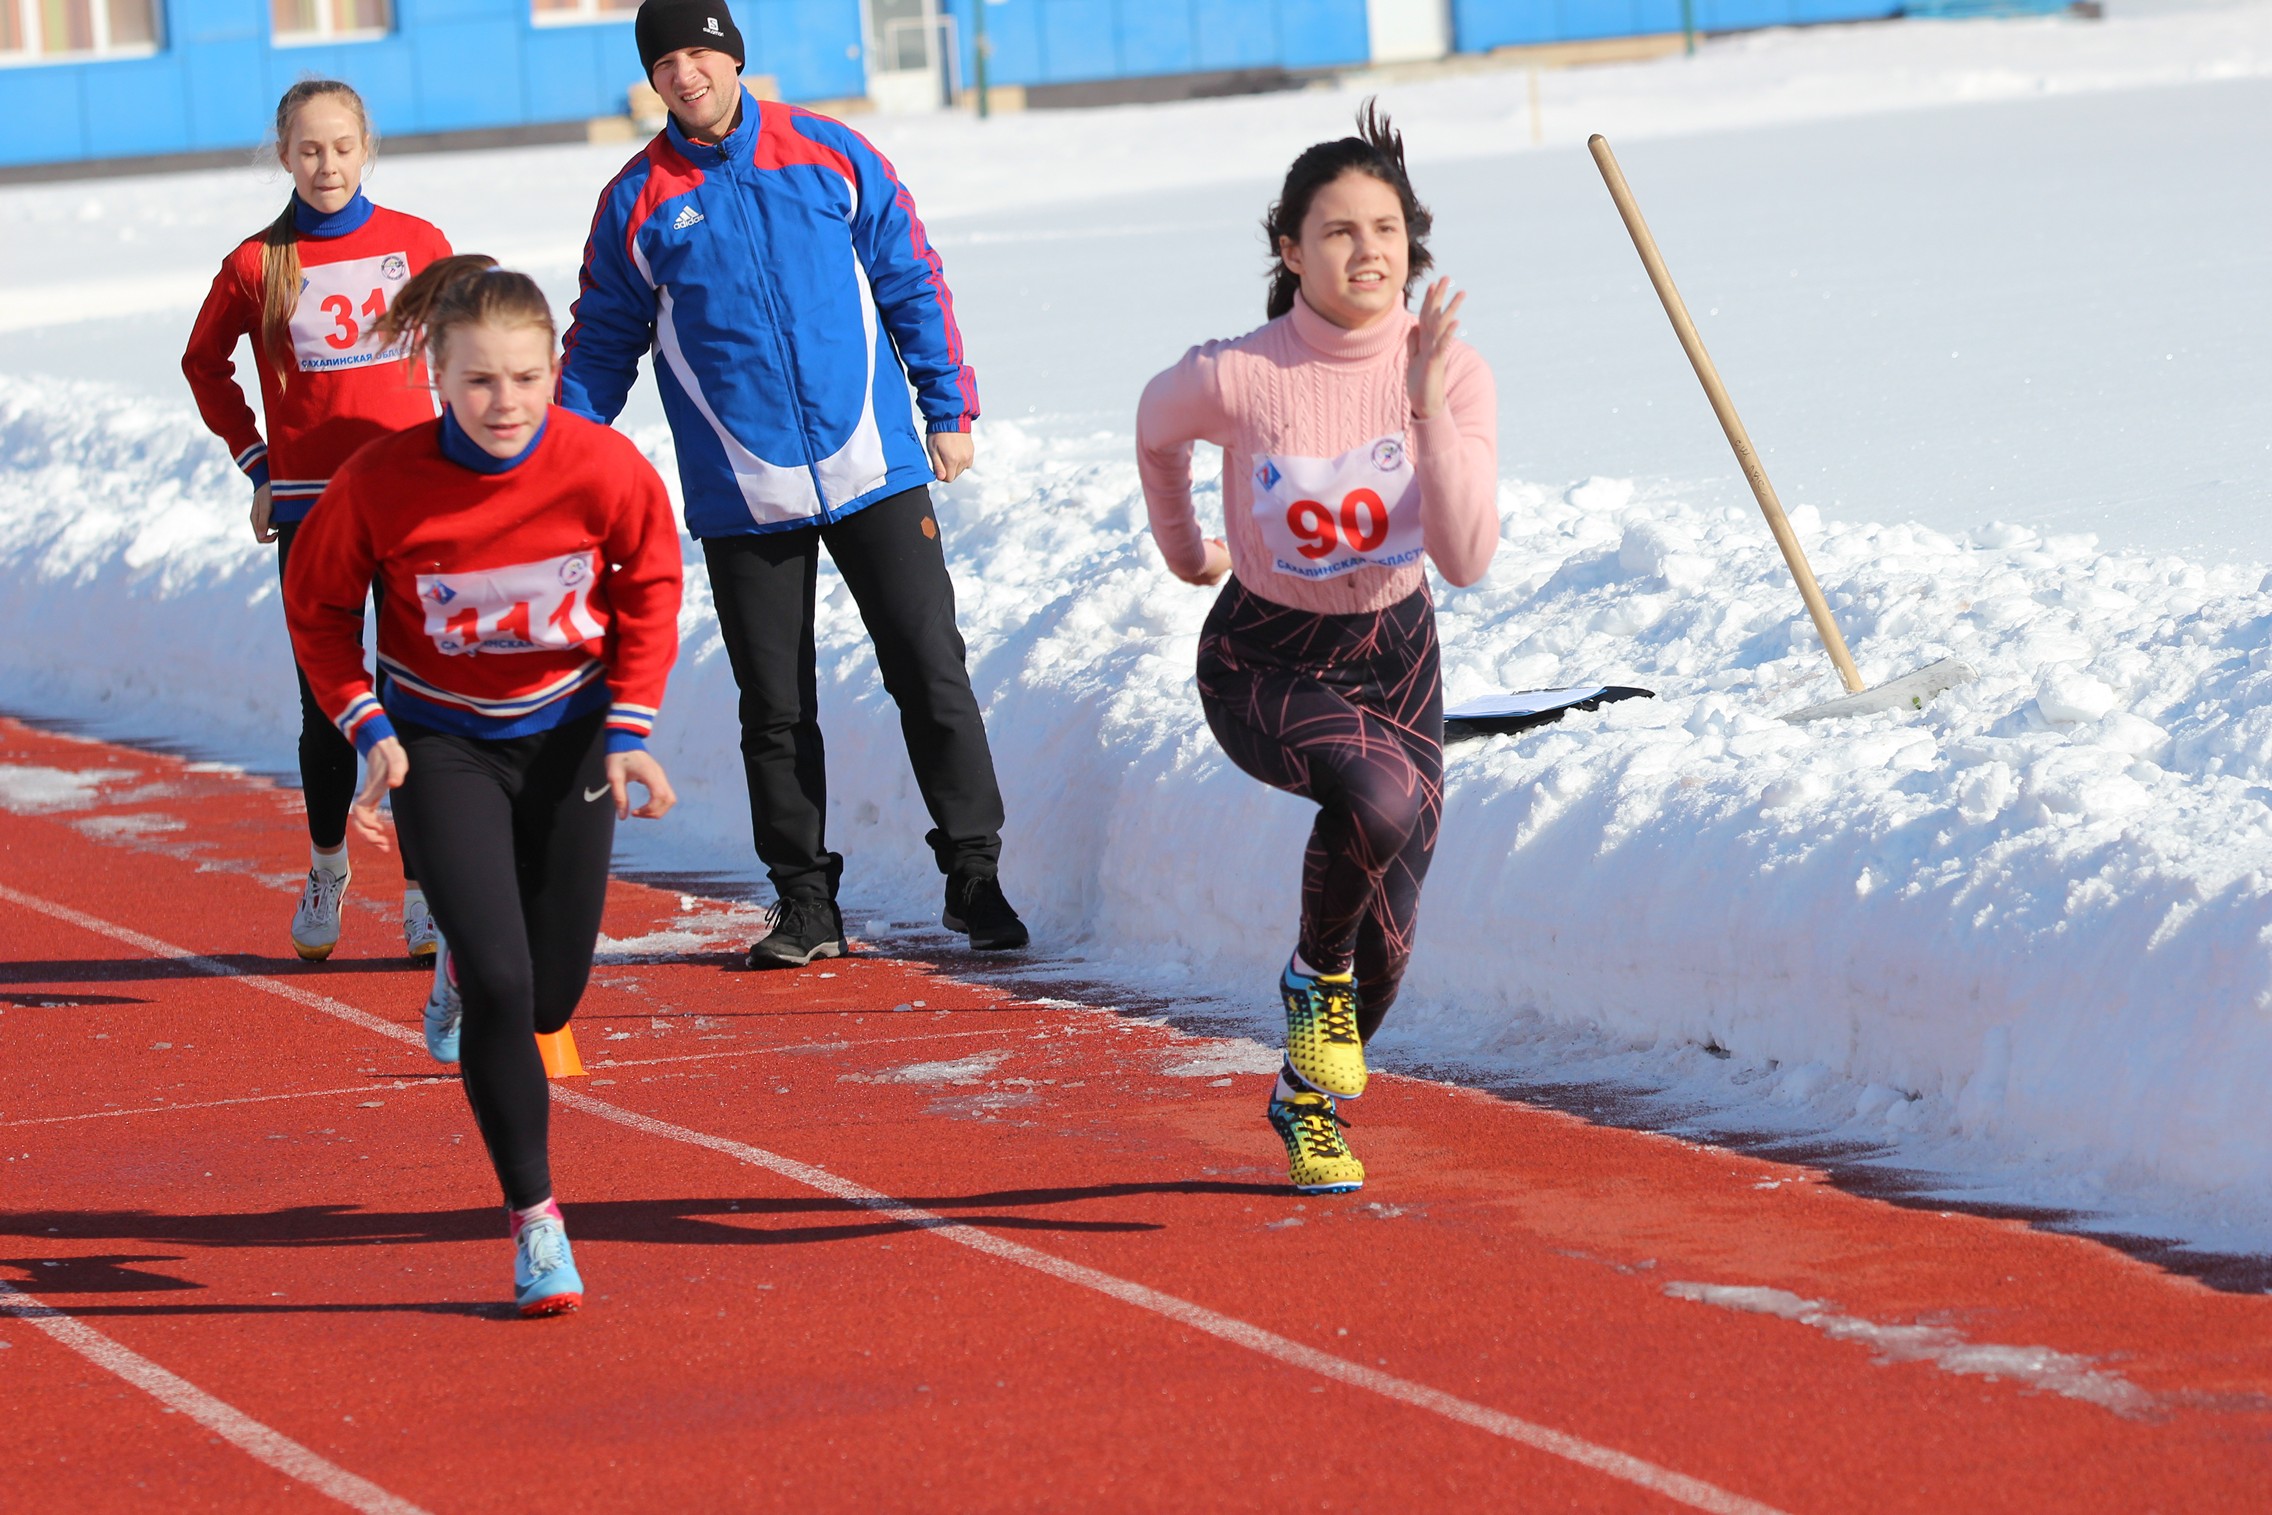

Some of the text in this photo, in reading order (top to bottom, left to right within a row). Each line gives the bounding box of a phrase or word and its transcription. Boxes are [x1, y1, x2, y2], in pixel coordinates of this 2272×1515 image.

[673, 214, 704, 230] adidas
[320, 287, 392, 350] 31
[301, 353, 373, 369] САХАЛИНСКАЯ
[1286, 487, 1389, 560] 90
[445, 589, 585, 646] 111
